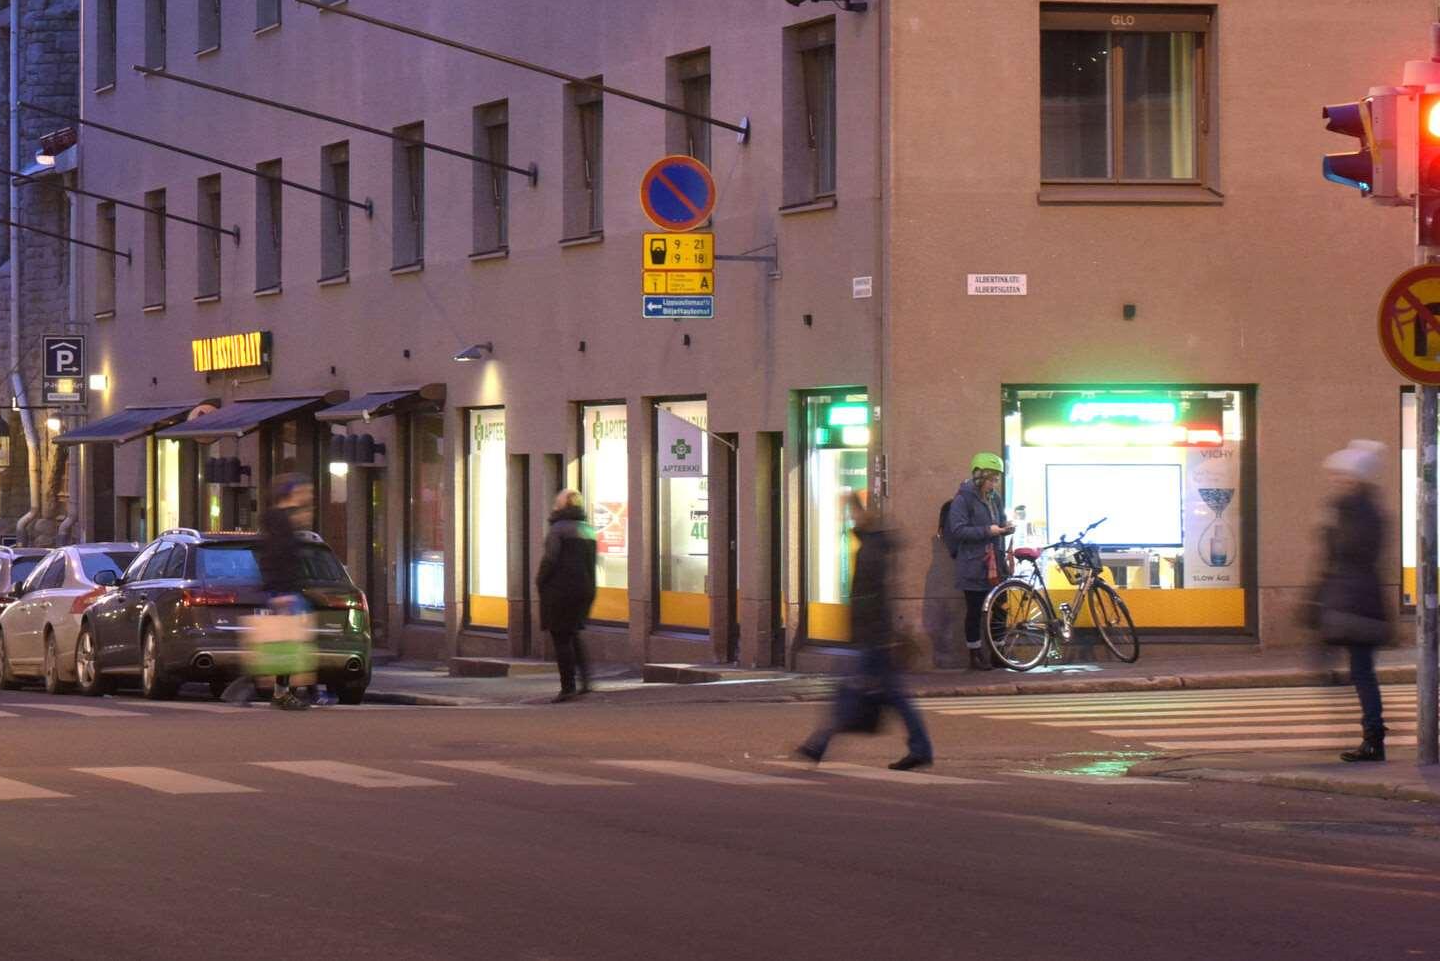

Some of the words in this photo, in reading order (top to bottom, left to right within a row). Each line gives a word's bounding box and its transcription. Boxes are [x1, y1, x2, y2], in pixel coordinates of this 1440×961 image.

[1111, 15, 1135, 26] GLO
[674, 239, 681, 249] 9
[694, 239, 705, 250] 21
[700, 275, 710, 289] A
[56, 350, 74, 373] P
[1200, 449, 1234, 459] VICHY
